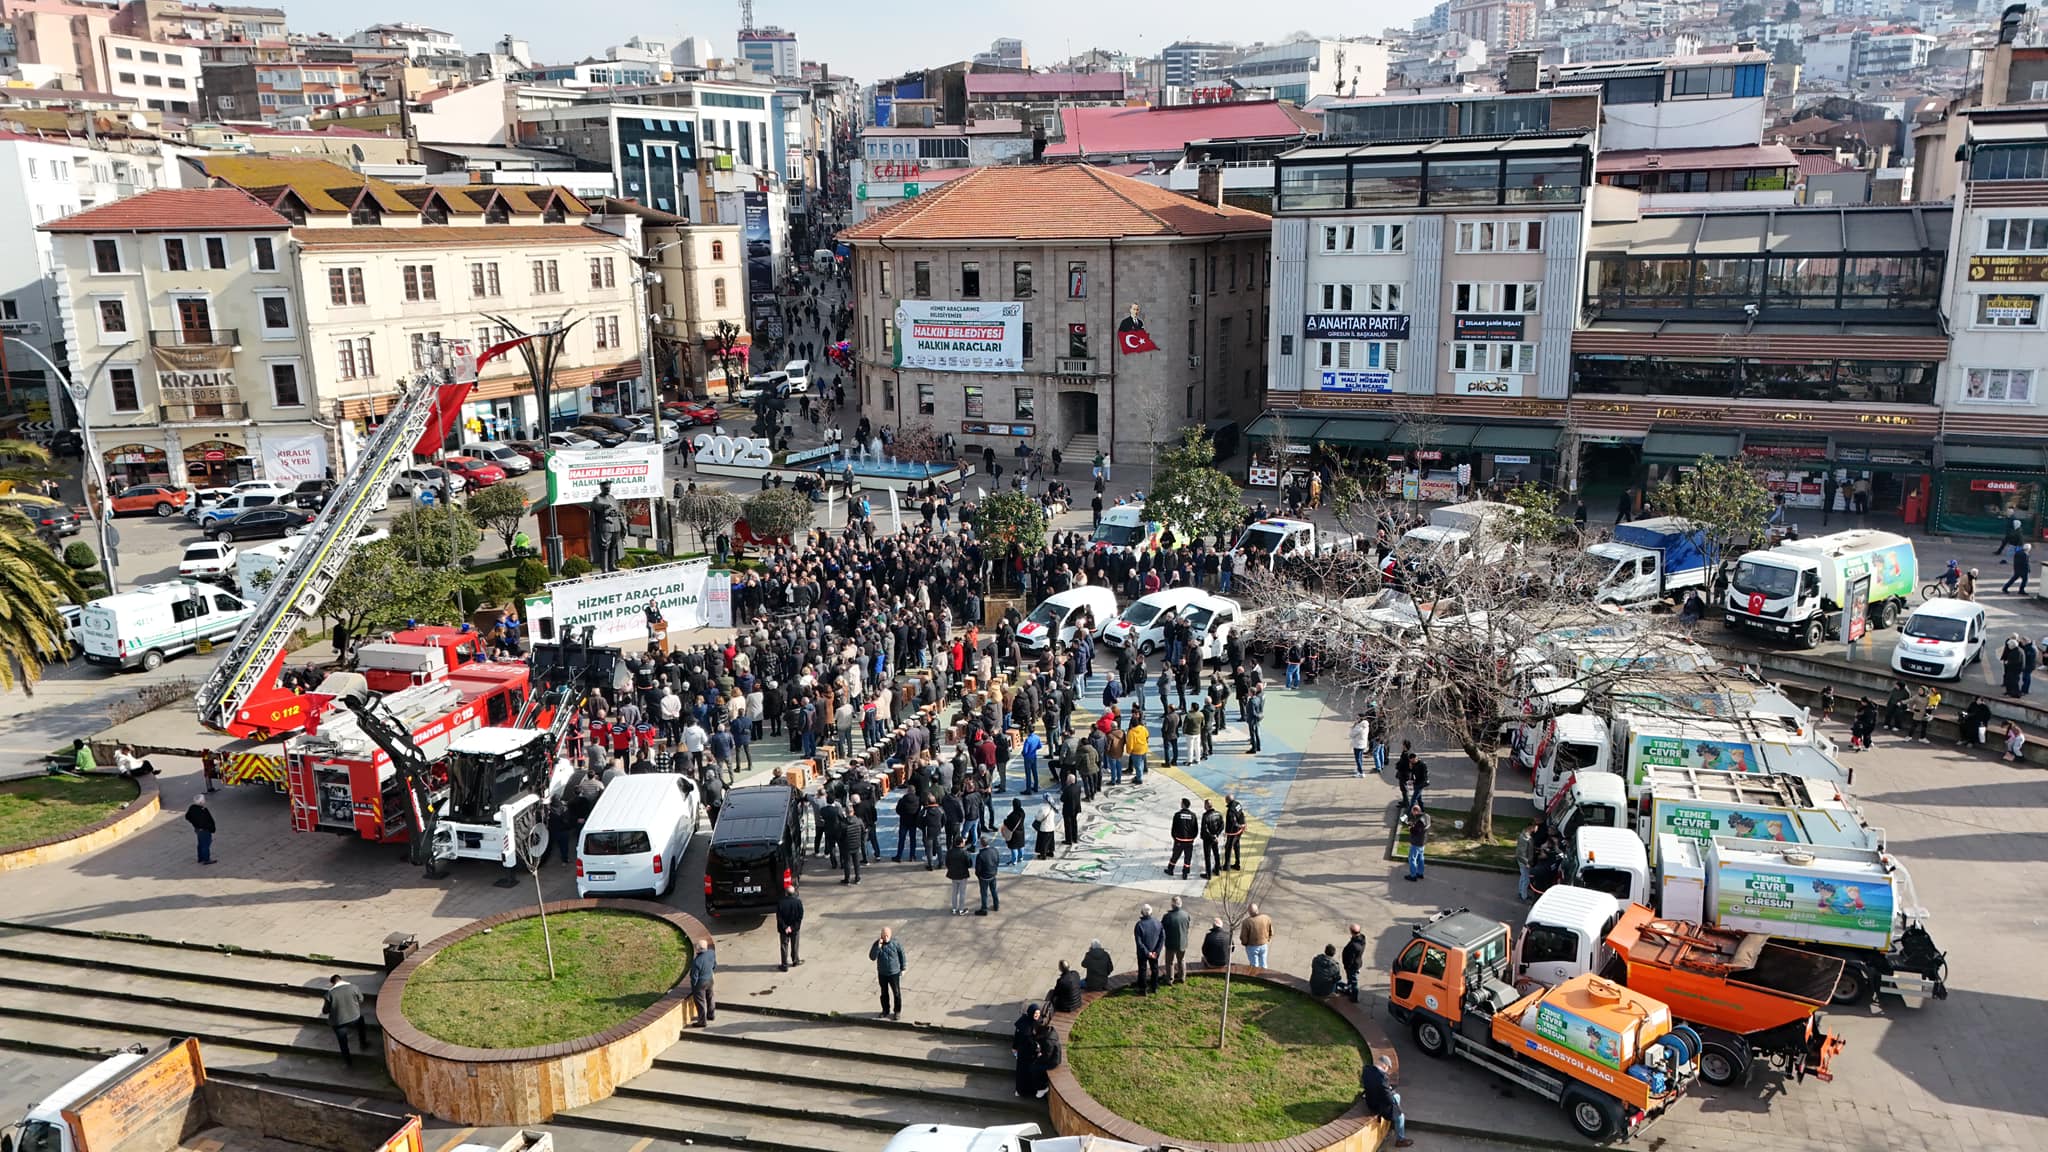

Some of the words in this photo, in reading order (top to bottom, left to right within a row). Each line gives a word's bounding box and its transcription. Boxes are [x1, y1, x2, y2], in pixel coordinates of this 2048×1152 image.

[1319, 317, 1367, 330] ANAHTAR
[914, 326, 946, 338] HALKIN
[948, 327, 1002, 339] BELEDİYESİ
[918, 341, 950, 350] HALKIN
[695, 434, 773, 466] 2025
[569, 469, 600, 479] HALKIN
[578, 593, 623, 610] HİZMET
[625, 582, 685, 601] ARAÇLARI
[563, 609, 613, 629] TANITIM
[283, 705, 300, 718] 112
[461, 706, 474, 721] 112
[1586, 1065, 1614, 1083] ARACI
